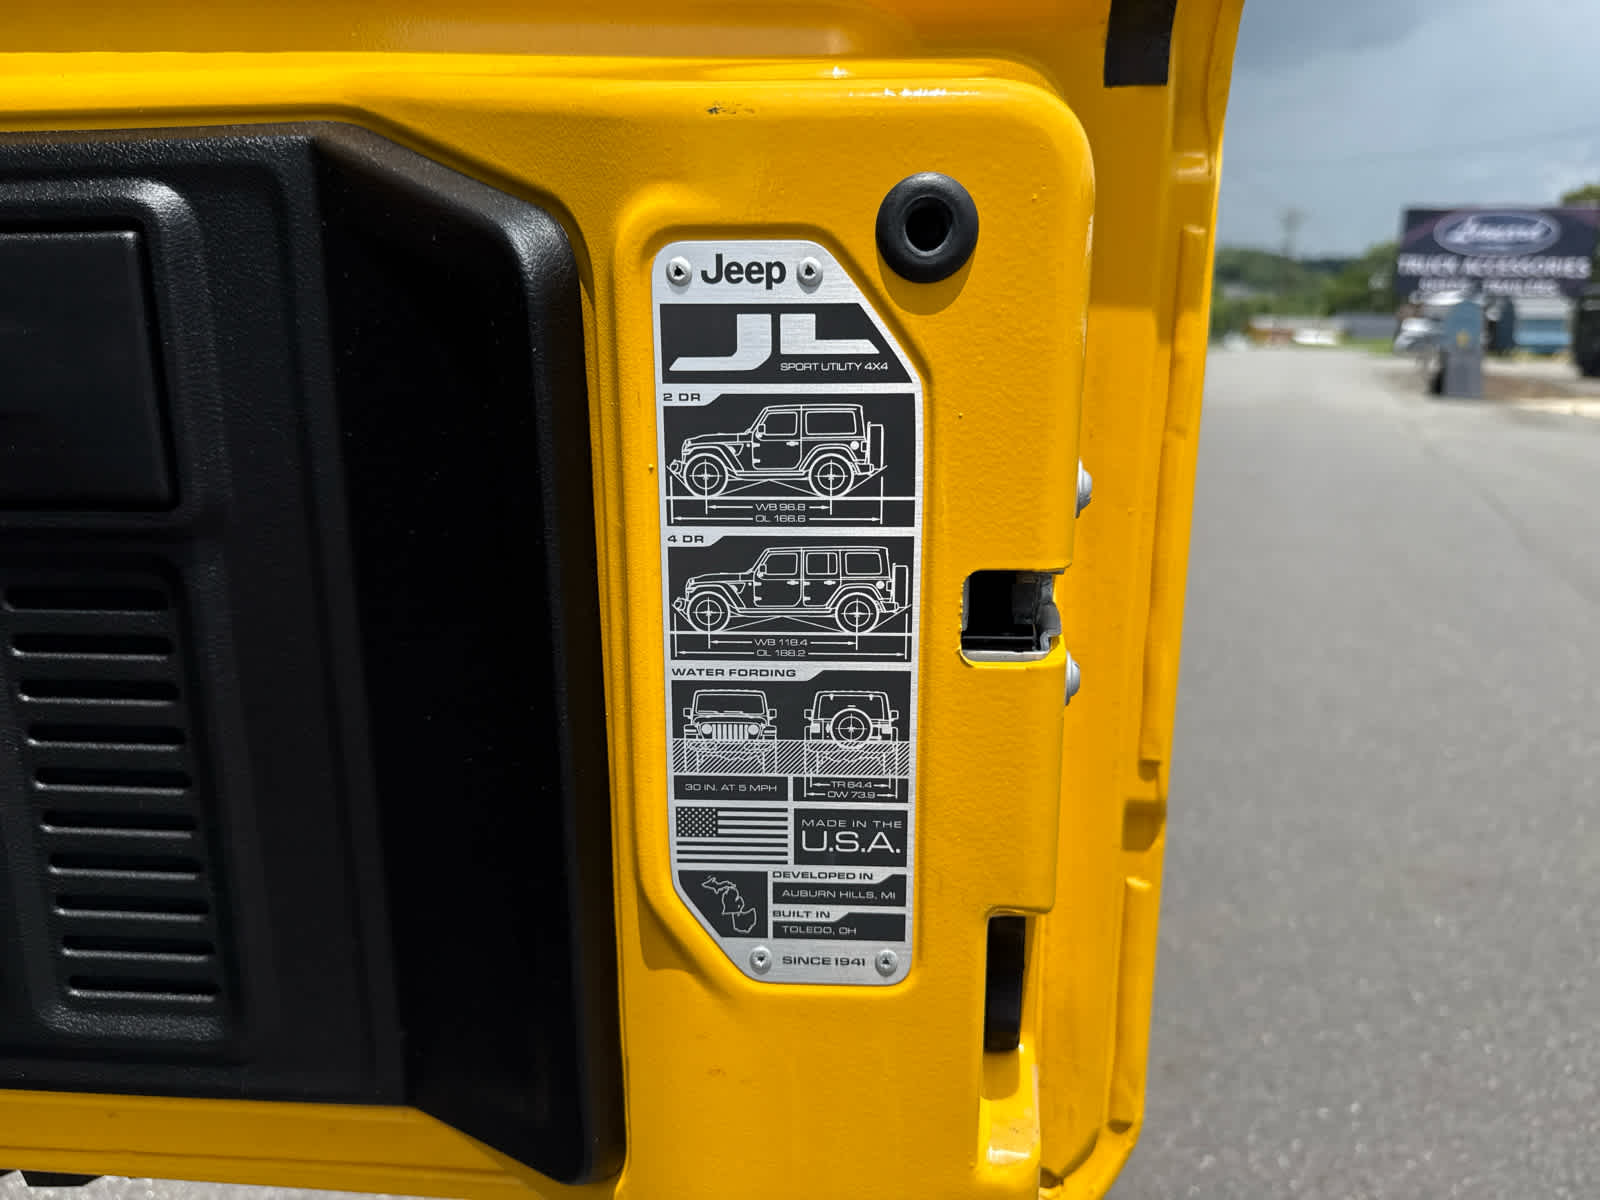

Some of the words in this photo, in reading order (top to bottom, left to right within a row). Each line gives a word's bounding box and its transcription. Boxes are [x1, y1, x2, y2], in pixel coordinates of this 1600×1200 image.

[700, 253, 787, 290] Jeep
[669, 313, 880, 371] JL
[779, 362, 819, 371] SPORT
[820, 362, 862, 371] UTILITY
[864, 362, 889, 371] 4X4
[663, 393, 673, 401] 2
[678, 393, 701, 401] DR
[755, 503, 778, 511] WB
[779, 503, 806, 511] 96.8
[774, 514, 806, 523] 166.6
[667, 535, 678, 543] 4
[682, 535, 704, 543] DR
[754, 638, 776, 646] WB
[778, 638, 808, 647] 118.4
[672, 668, 725, 677] WATER
[729, 668, 796, 678] FORDING
[738, 784, 747, 792] 5
[749, 784, 777, 792] MPH
[847, 781, 873, 789] 64.4
[851, 791, 876, 799] 73.9
[802, 819, 847, 828] MADE
[852, 819, 867, 828] IN
[872, 820, 903, 828] THE
[802, 830, 901, 853] U.S.A.
[772, 871, 856, 880] DEVELOPED
[859, 872, 873, 880] IN
[782, 889, 836, 898] AUBURN
[839, 891, 878, 900] HILLS,
[881, 892, 896, 900] MI
[772, 910, 812, 918] BUILT
[782, 925, 835, 935] TOLEDO,
[838, 927, 857, 935] OH
[782, 956, 832, 965] SINCE
[835, 957, 865, 966] 1941
